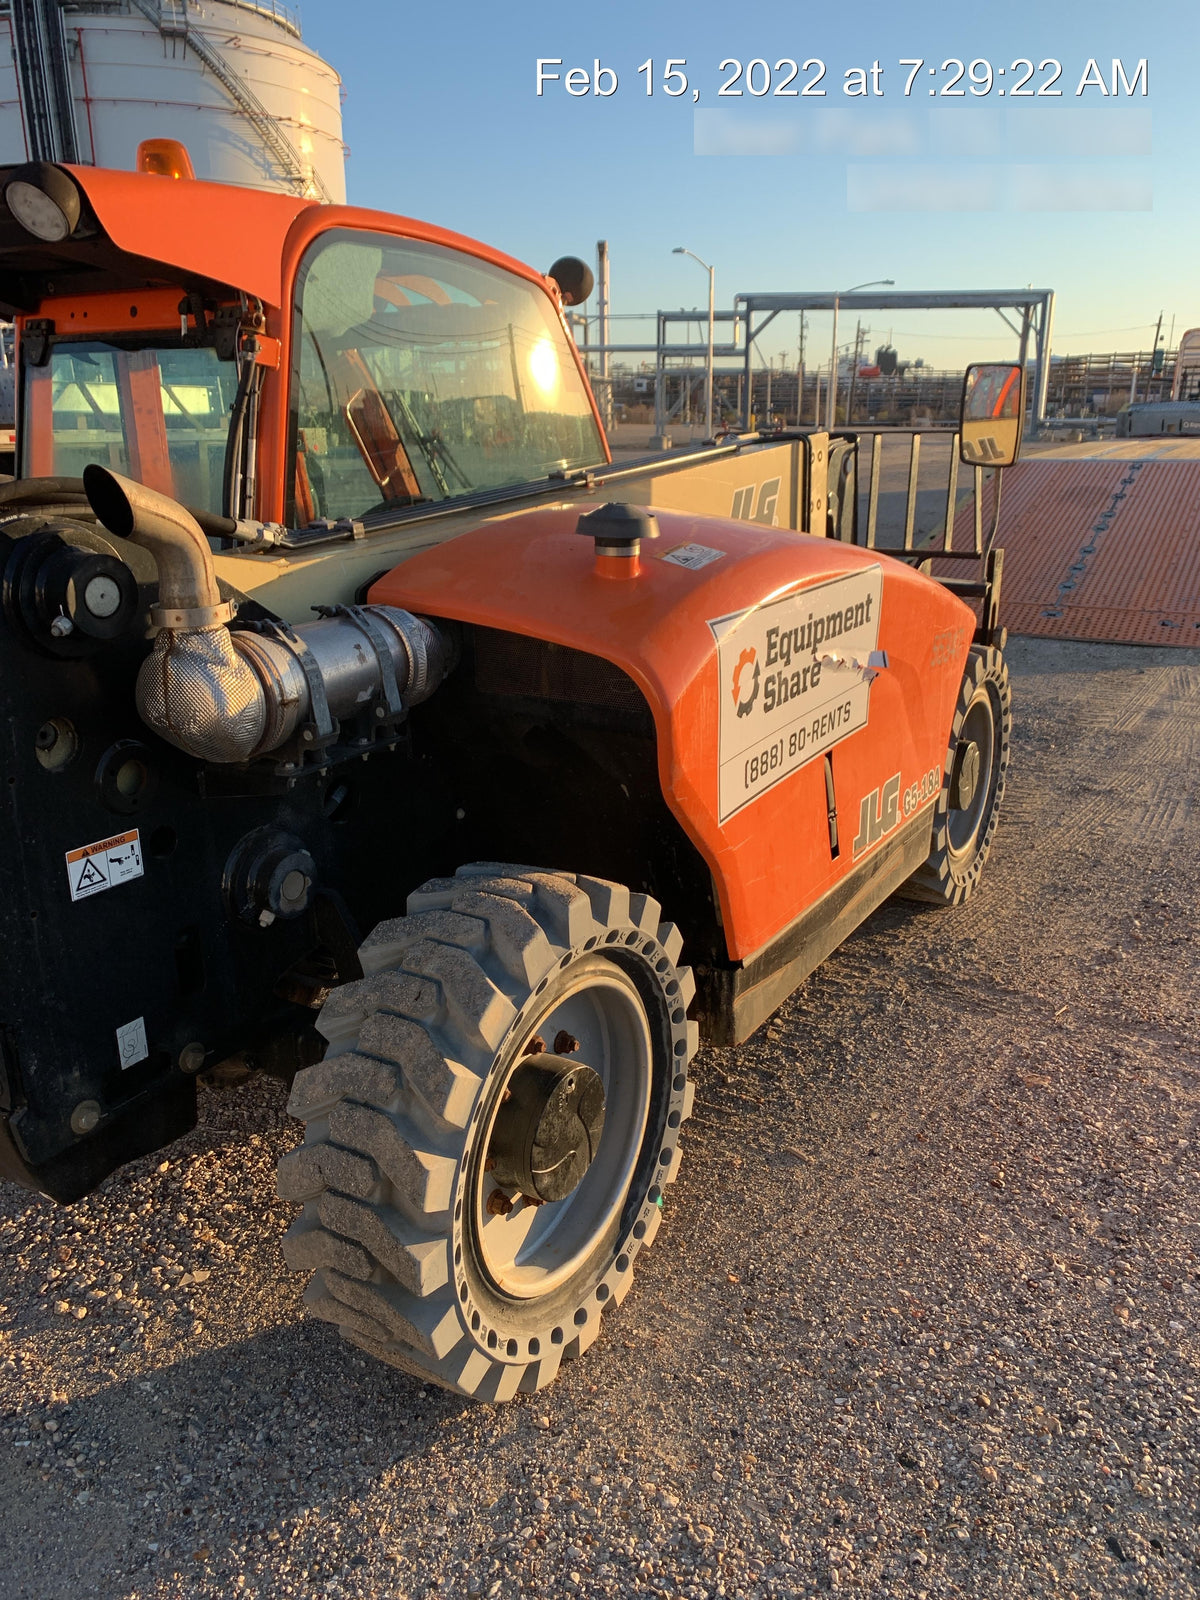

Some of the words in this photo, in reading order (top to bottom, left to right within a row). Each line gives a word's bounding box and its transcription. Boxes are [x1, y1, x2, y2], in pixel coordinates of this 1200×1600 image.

[764, 592, 873, 668] Equipment
[763, 661, 823, 714] Share
[744, 738, 784, 789] (888)
[788, 700, 852, 757] 80-RENTS
[90, 836, 126, 853] WARNING
[852, 771, 902, 863] JLG
[902, 764, 941, 817] G5-18A
